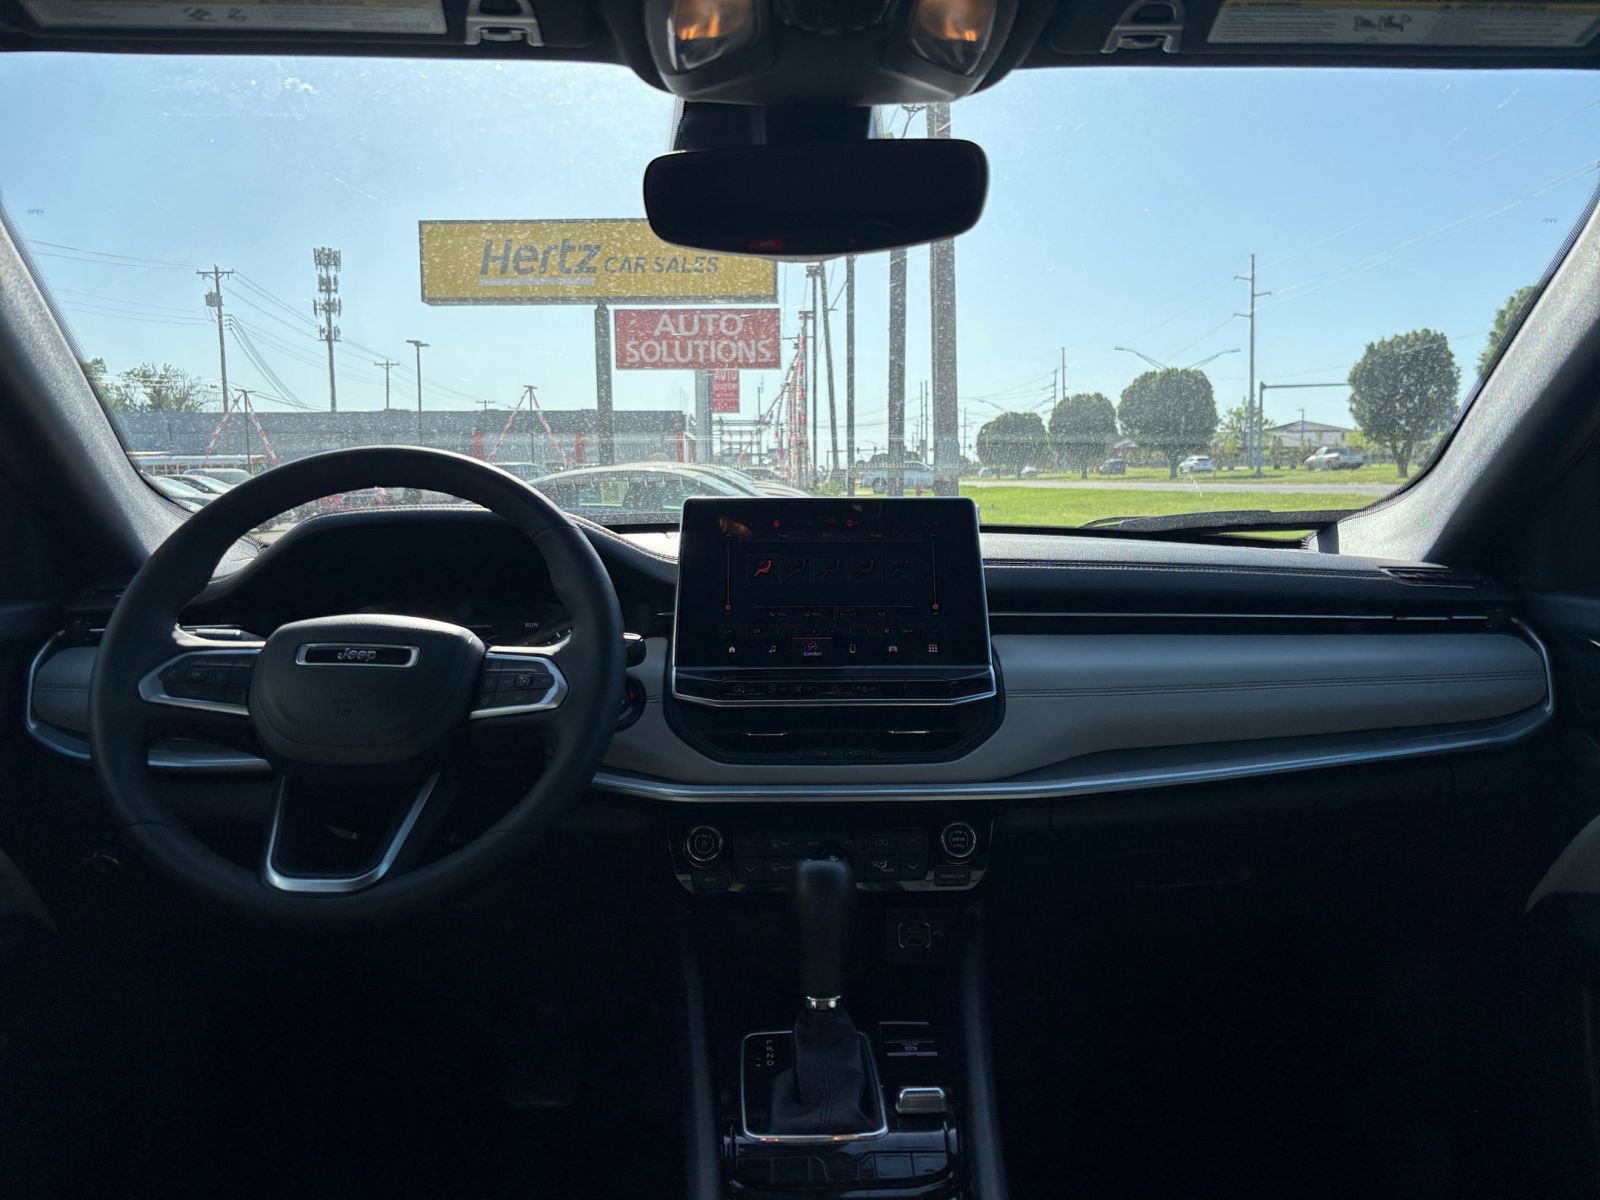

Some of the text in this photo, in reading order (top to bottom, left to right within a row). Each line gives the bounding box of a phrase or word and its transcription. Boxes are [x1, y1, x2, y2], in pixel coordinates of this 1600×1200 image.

[480, 238, 720, 275] Hertz CAR SALES
[653, 313, 744, 337] AUTO
[624, 338, 772, 364] SOLUTIONS
[714, 369, 738, 380] AUTO
[524, 621, 539, 629] RUN
[336, 647, 377, 662] Jeep
